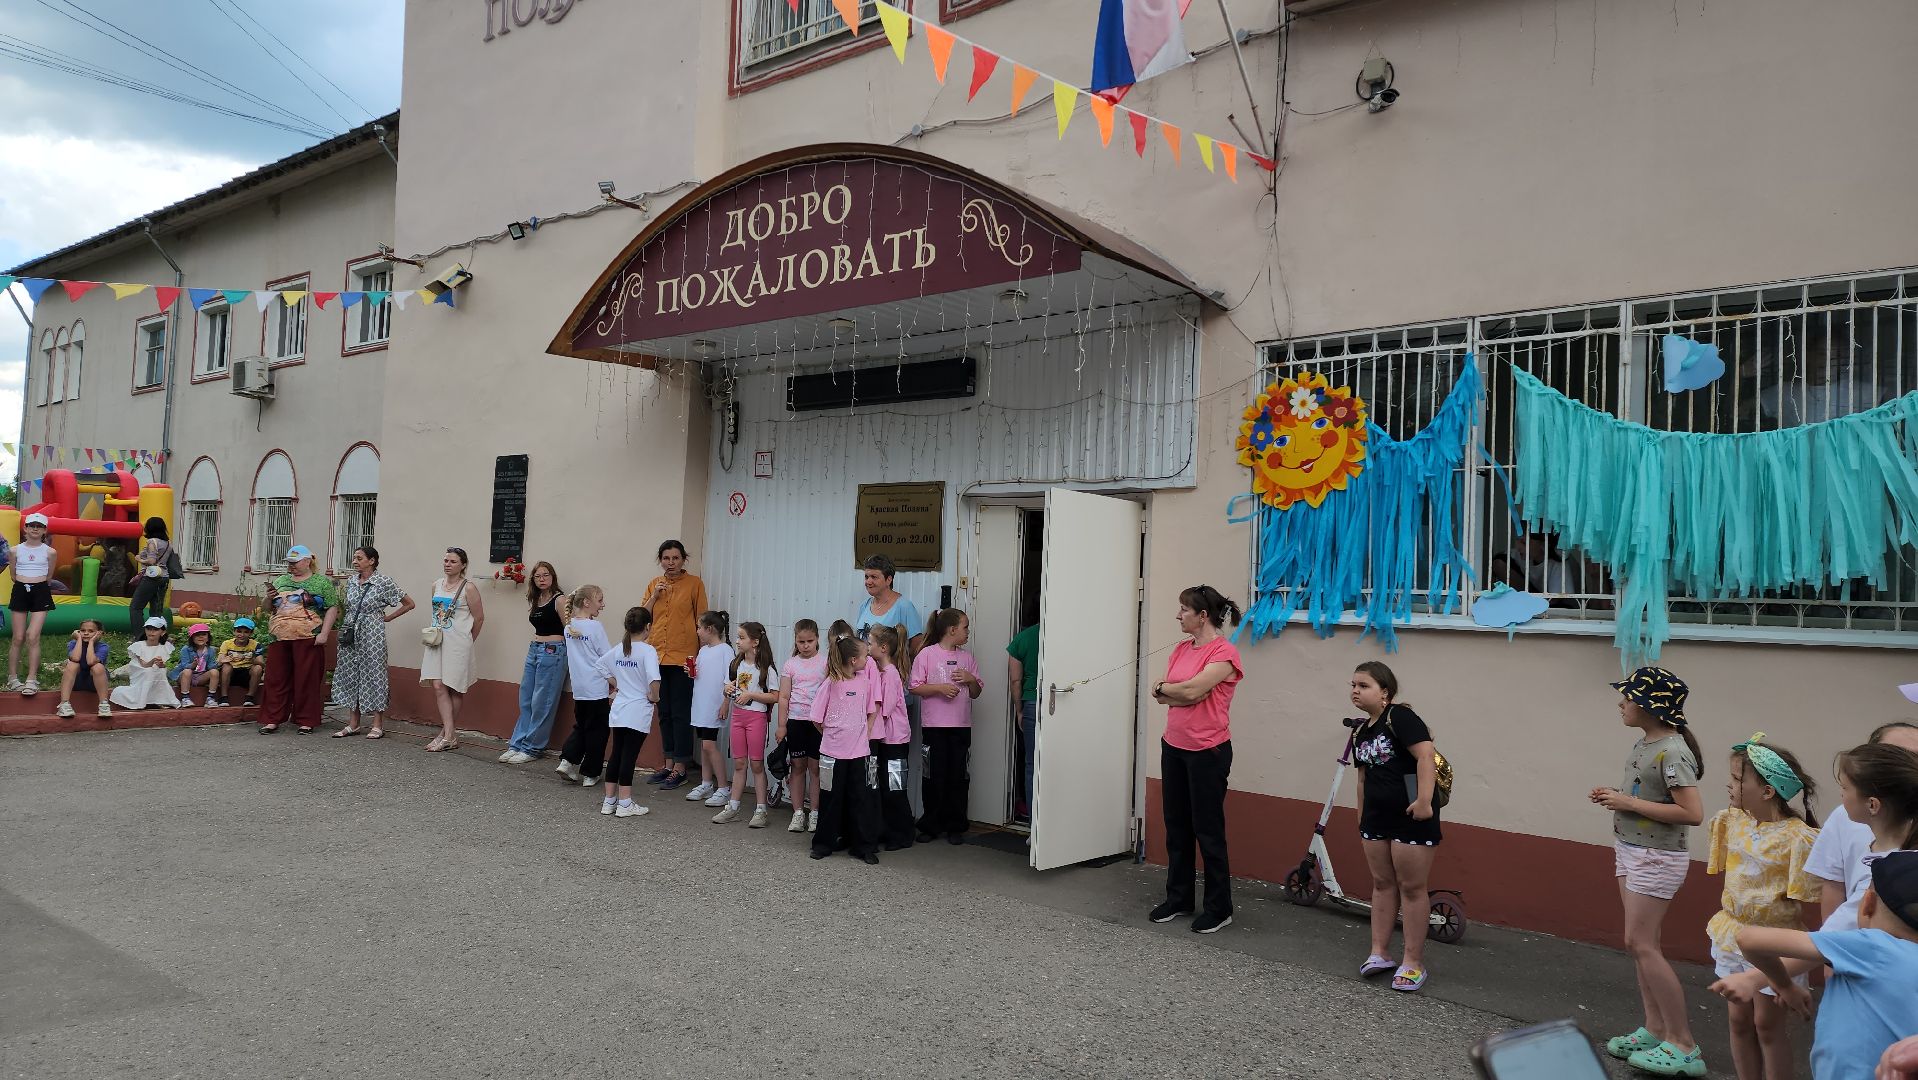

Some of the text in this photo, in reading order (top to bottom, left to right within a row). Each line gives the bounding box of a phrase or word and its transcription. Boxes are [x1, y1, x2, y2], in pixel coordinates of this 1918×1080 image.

[720, 184, 852, 255] ДОБРО
[655, 228, 936, 315] ПОЖАЛОВАТЬ
[868, 534, 893, 544] 09.00
[896, 536, 907, 545] до
[909, 534, 935, 544] 22.00
